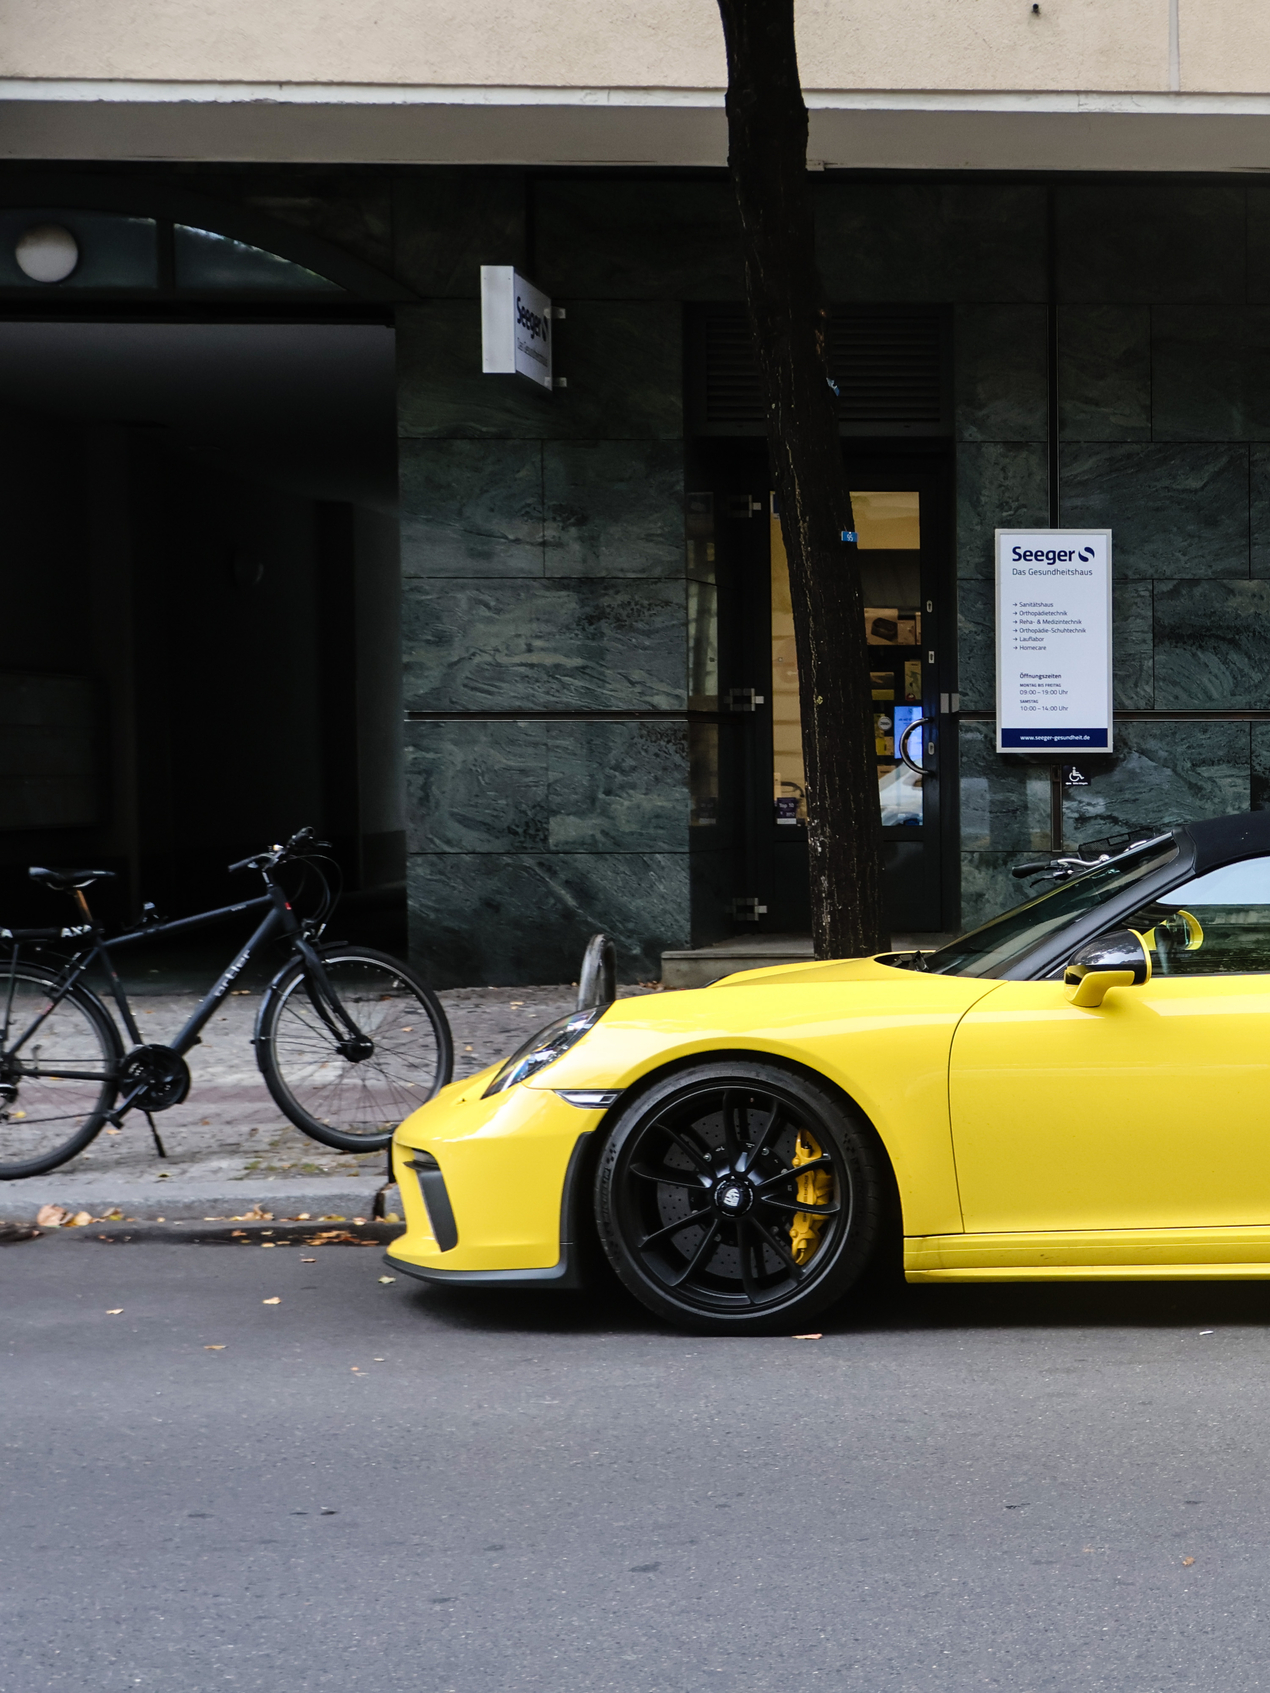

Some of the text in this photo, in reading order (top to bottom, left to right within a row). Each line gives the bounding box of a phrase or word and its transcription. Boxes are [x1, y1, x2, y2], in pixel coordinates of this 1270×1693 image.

[517, 296, 541, 339] Seeger
[1012, 546, 1076, 565] Seeger
[1012, 568, 1093, 576] Das Gesundheitshaus
[1019, 672, 1062, 680] Öffnungszeiten
[1020, 734, 1091, 742] www.seeger-gesundheit.de
